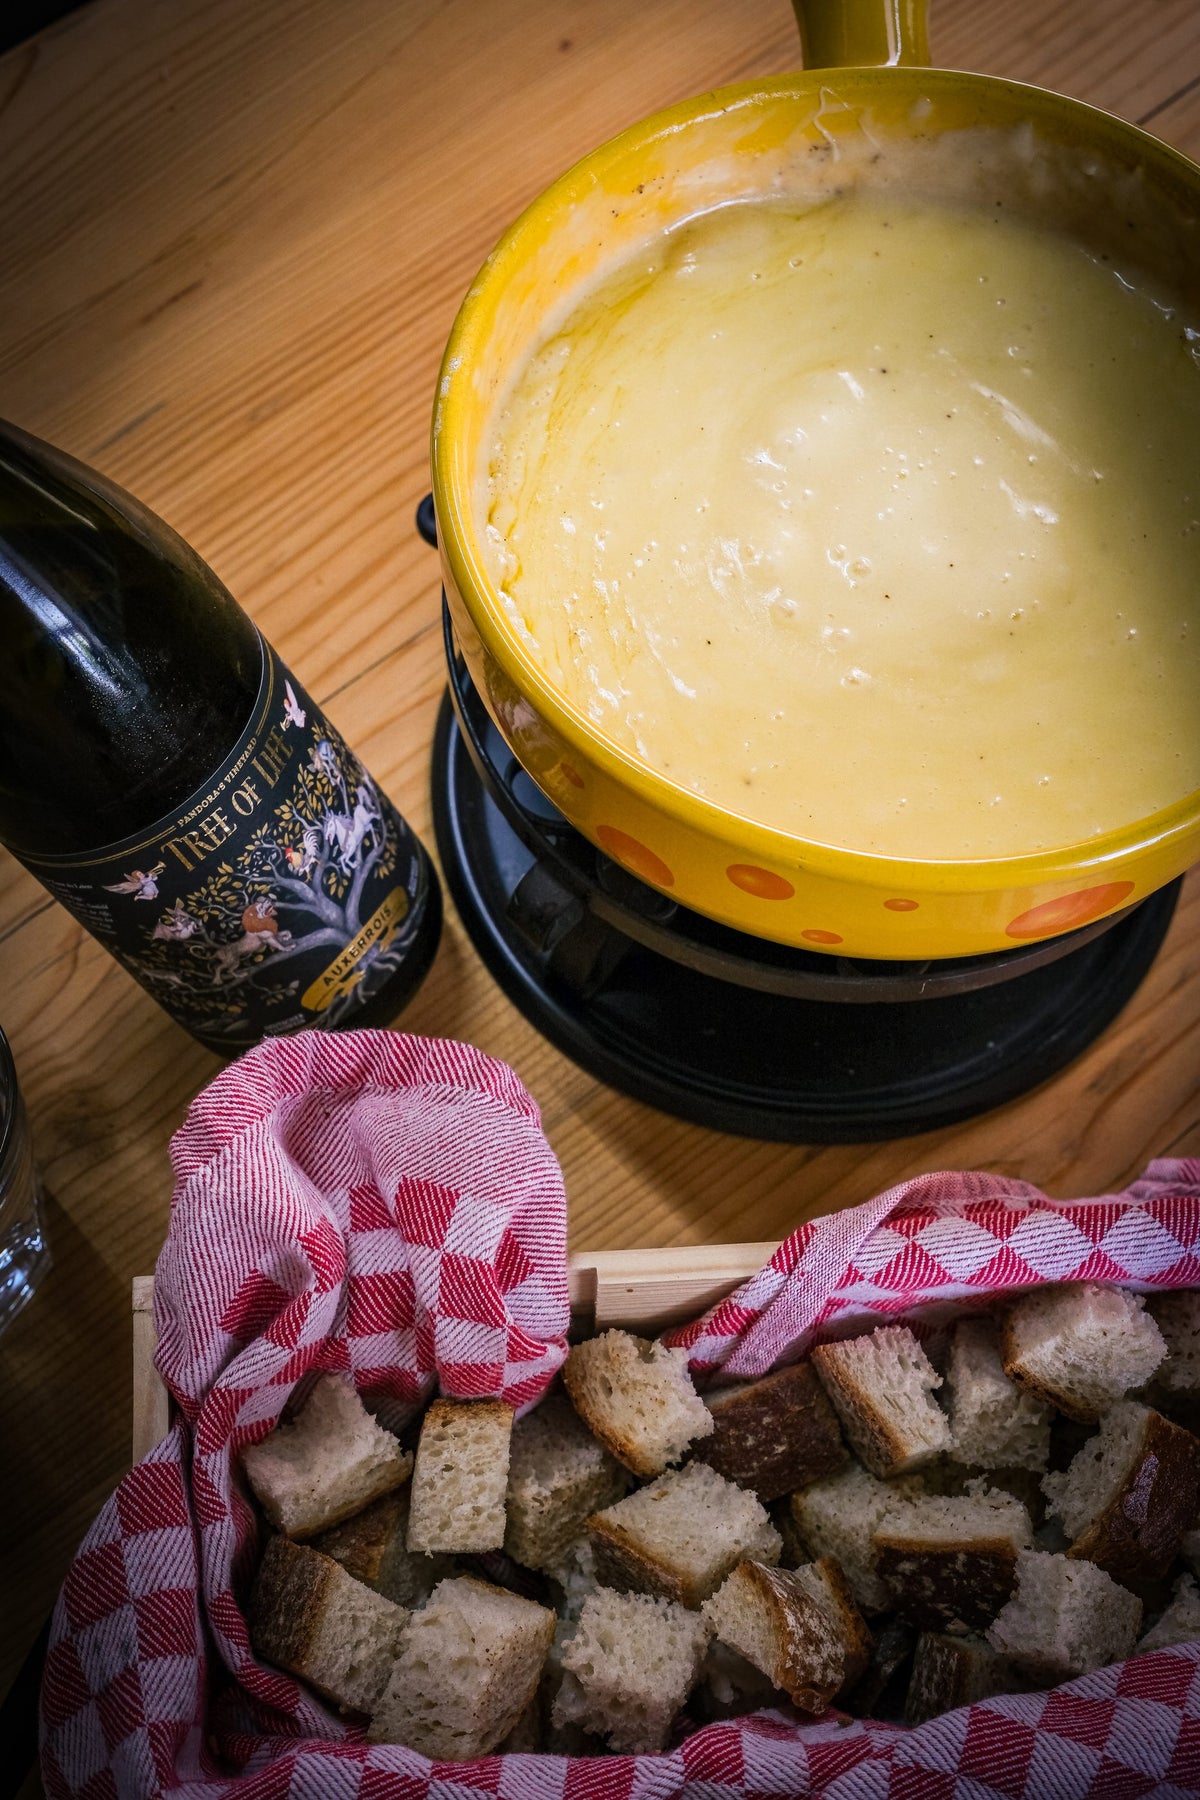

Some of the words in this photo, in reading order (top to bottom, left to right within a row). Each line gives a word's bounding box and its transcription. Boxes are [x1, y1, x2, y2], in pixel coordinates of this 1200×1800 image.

[160, 807, 238, 872] TREE
[231, 776, 262, 816] OF
[251, 725, 294, 789] LIFE
[177, 782, 226, 827] PANDORA'S
[224, 737, 257, 784] VINEYARD
[323, 906, 393, 987] AUXERROIS
